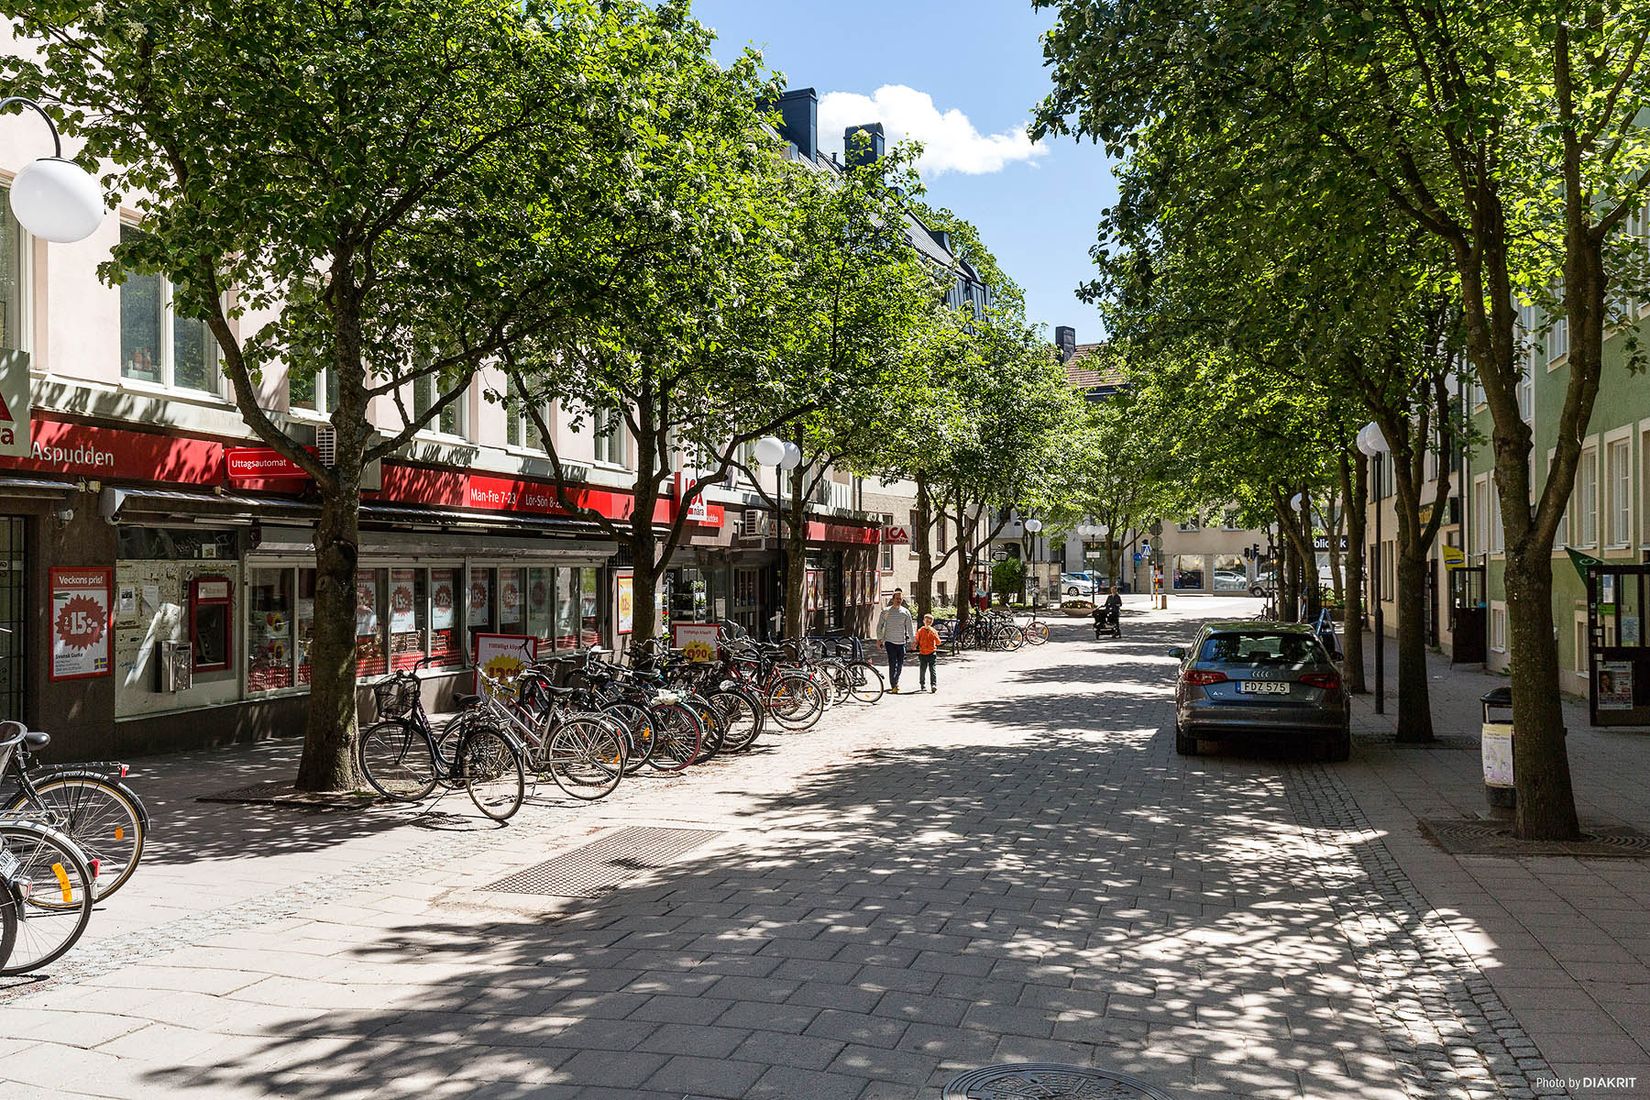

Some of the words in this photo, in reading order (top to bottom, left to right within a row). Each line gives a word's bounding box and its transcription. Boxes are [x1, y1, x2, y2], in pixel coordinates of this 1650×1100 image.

[31, 441, 114, 466] Aspudden
[231, 459, 287, 470] Uttagsautomat
[501, 491, 516, 505] 7-23
[885, 527, 908, 539] ICA
[59, 575, 87, 584] Veckans
[64, 616, 69, 625] 2
[1244, 682, 1265, 691] FDZ
[1266, 682, 1286, 692] 575
